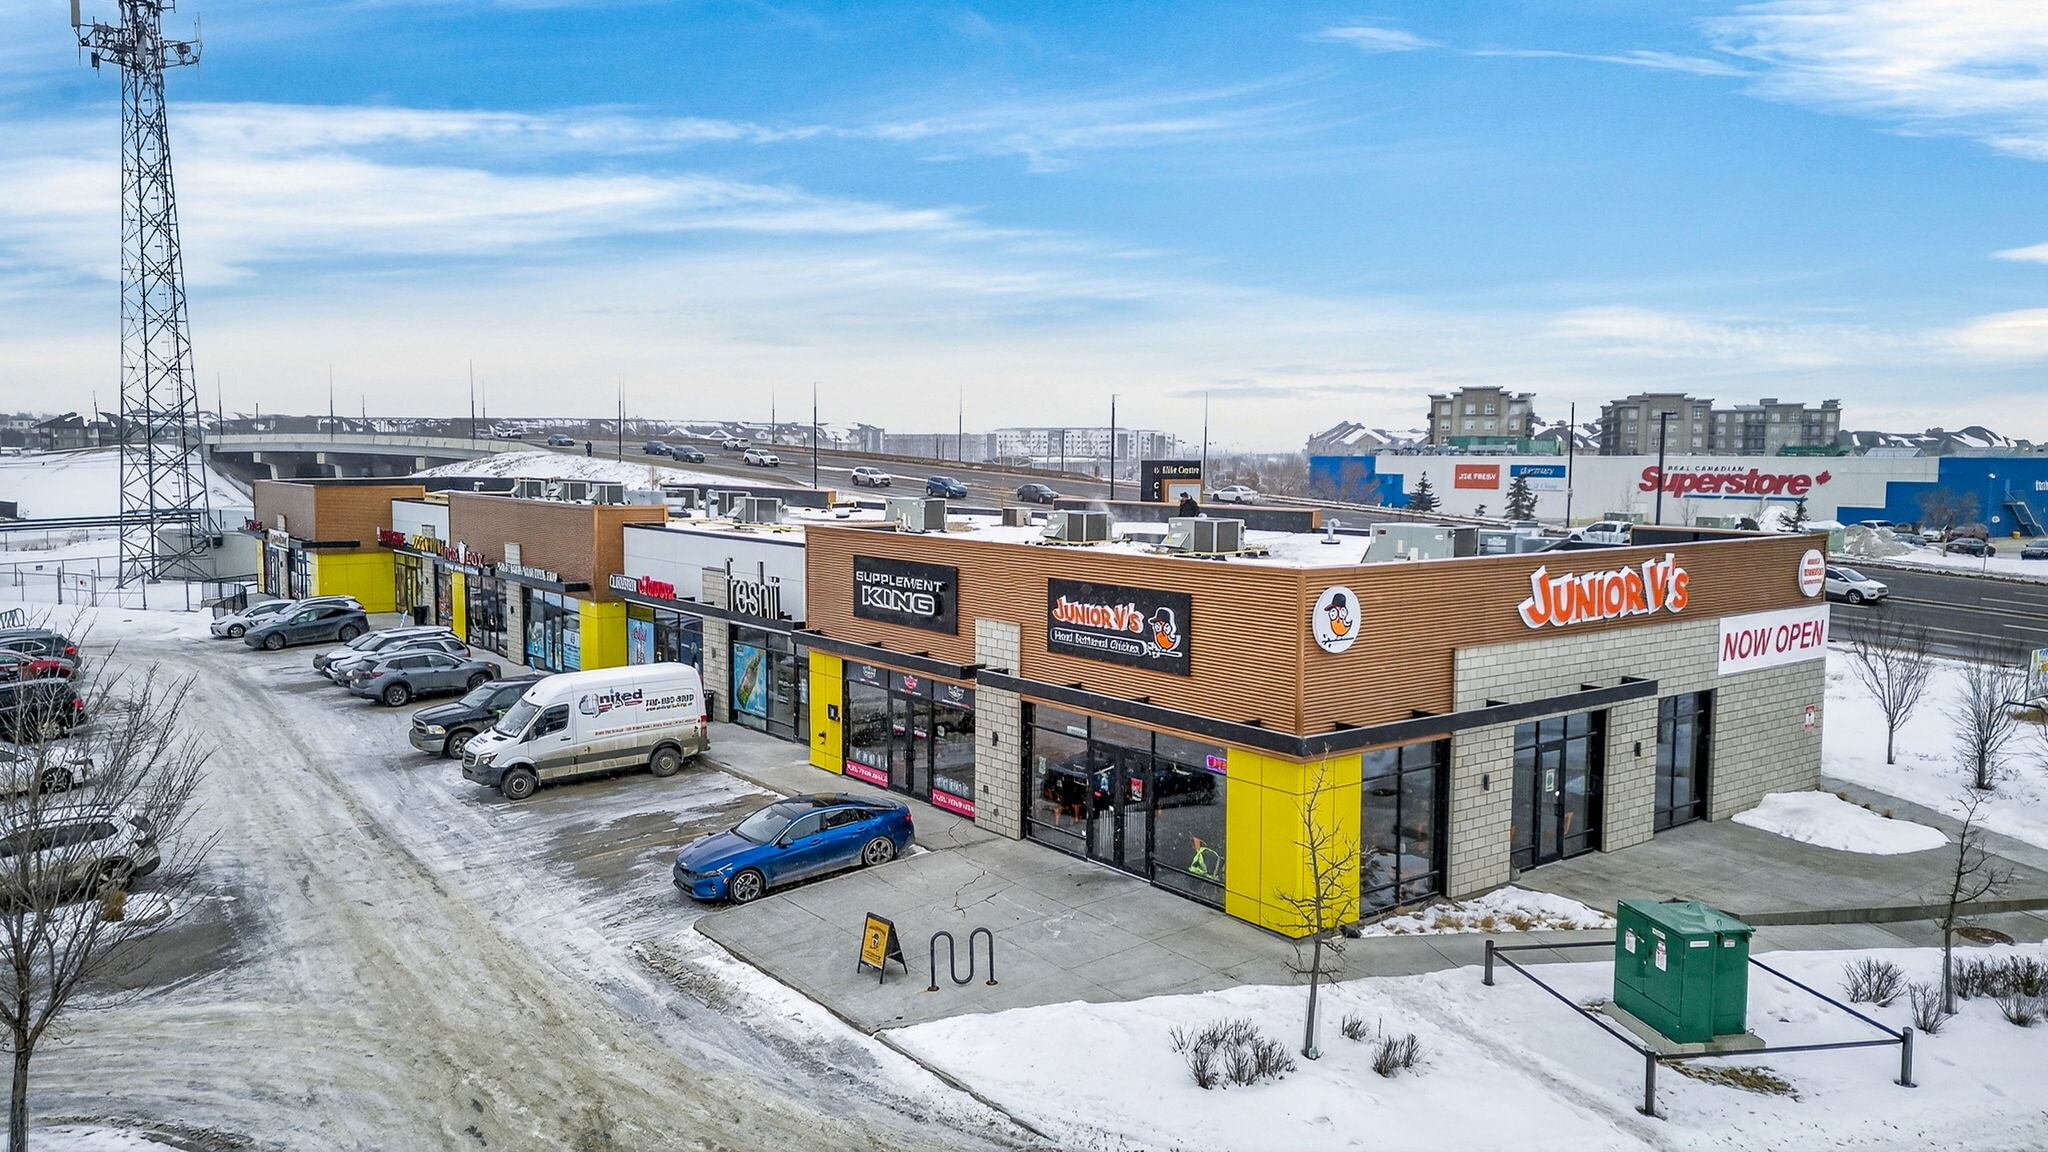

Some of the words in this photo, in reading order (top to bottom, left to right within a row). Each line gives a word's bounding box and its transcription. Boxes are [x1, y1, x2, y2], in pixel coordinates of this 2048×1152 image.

[1638, 465, 1812, 498] Superstore
[723, 557, 781, 620] freshii
[856, 571, 942, 592] SUPPLEMENT
[1518, 565, 1648, 629] JUNIOR
[862, 585, 935, 615] KING
[1052, 595, 1115, 630] JUNIOR
[1723, 627, 1772, 661] NOW
[1776, 619, 1824, 653] OPEN
